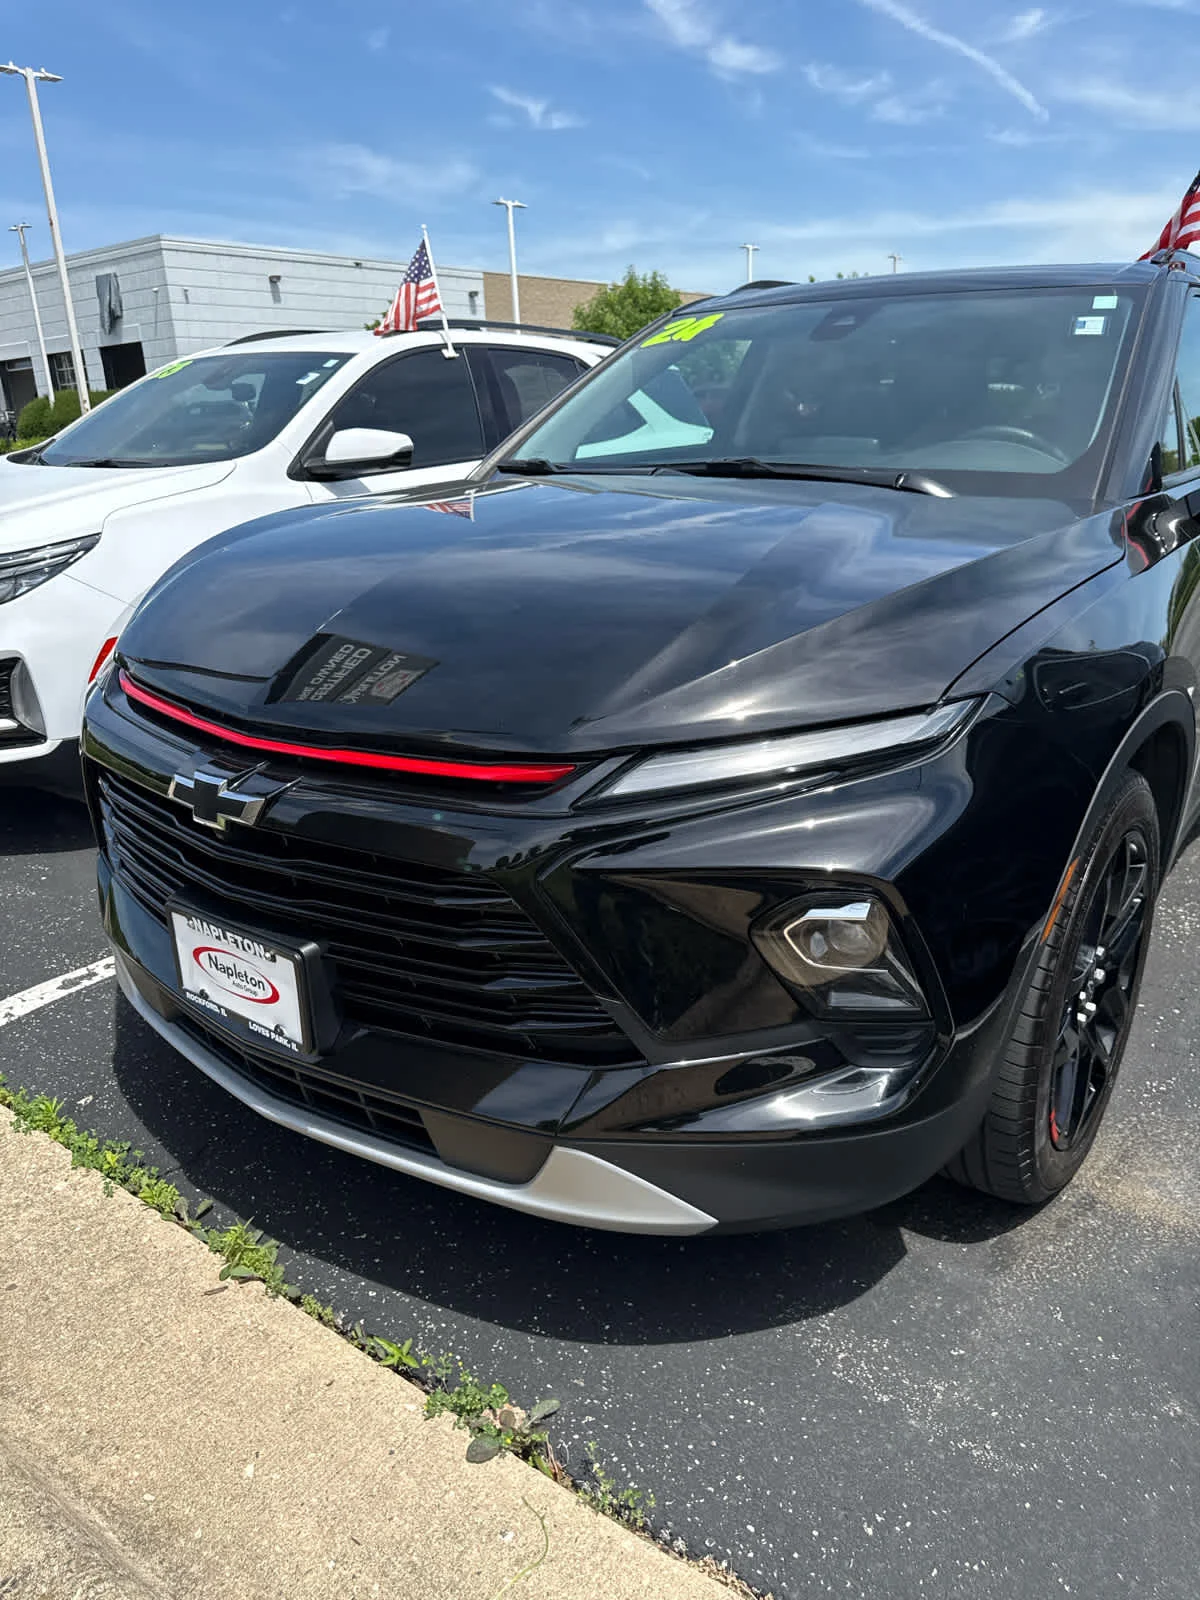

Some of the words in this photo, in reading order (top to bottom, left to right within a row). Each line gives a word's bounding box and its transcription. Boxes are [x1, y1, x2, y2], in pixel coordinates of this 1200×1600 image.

[191, 916, 265, 958] NAPLETON
[207, 952, 266, 991] Napleton
[220, 1007, 228, 1017] IL
[248, 1020, 271, 1038] LOVES
[291, 1042, 299, 1052] IL
